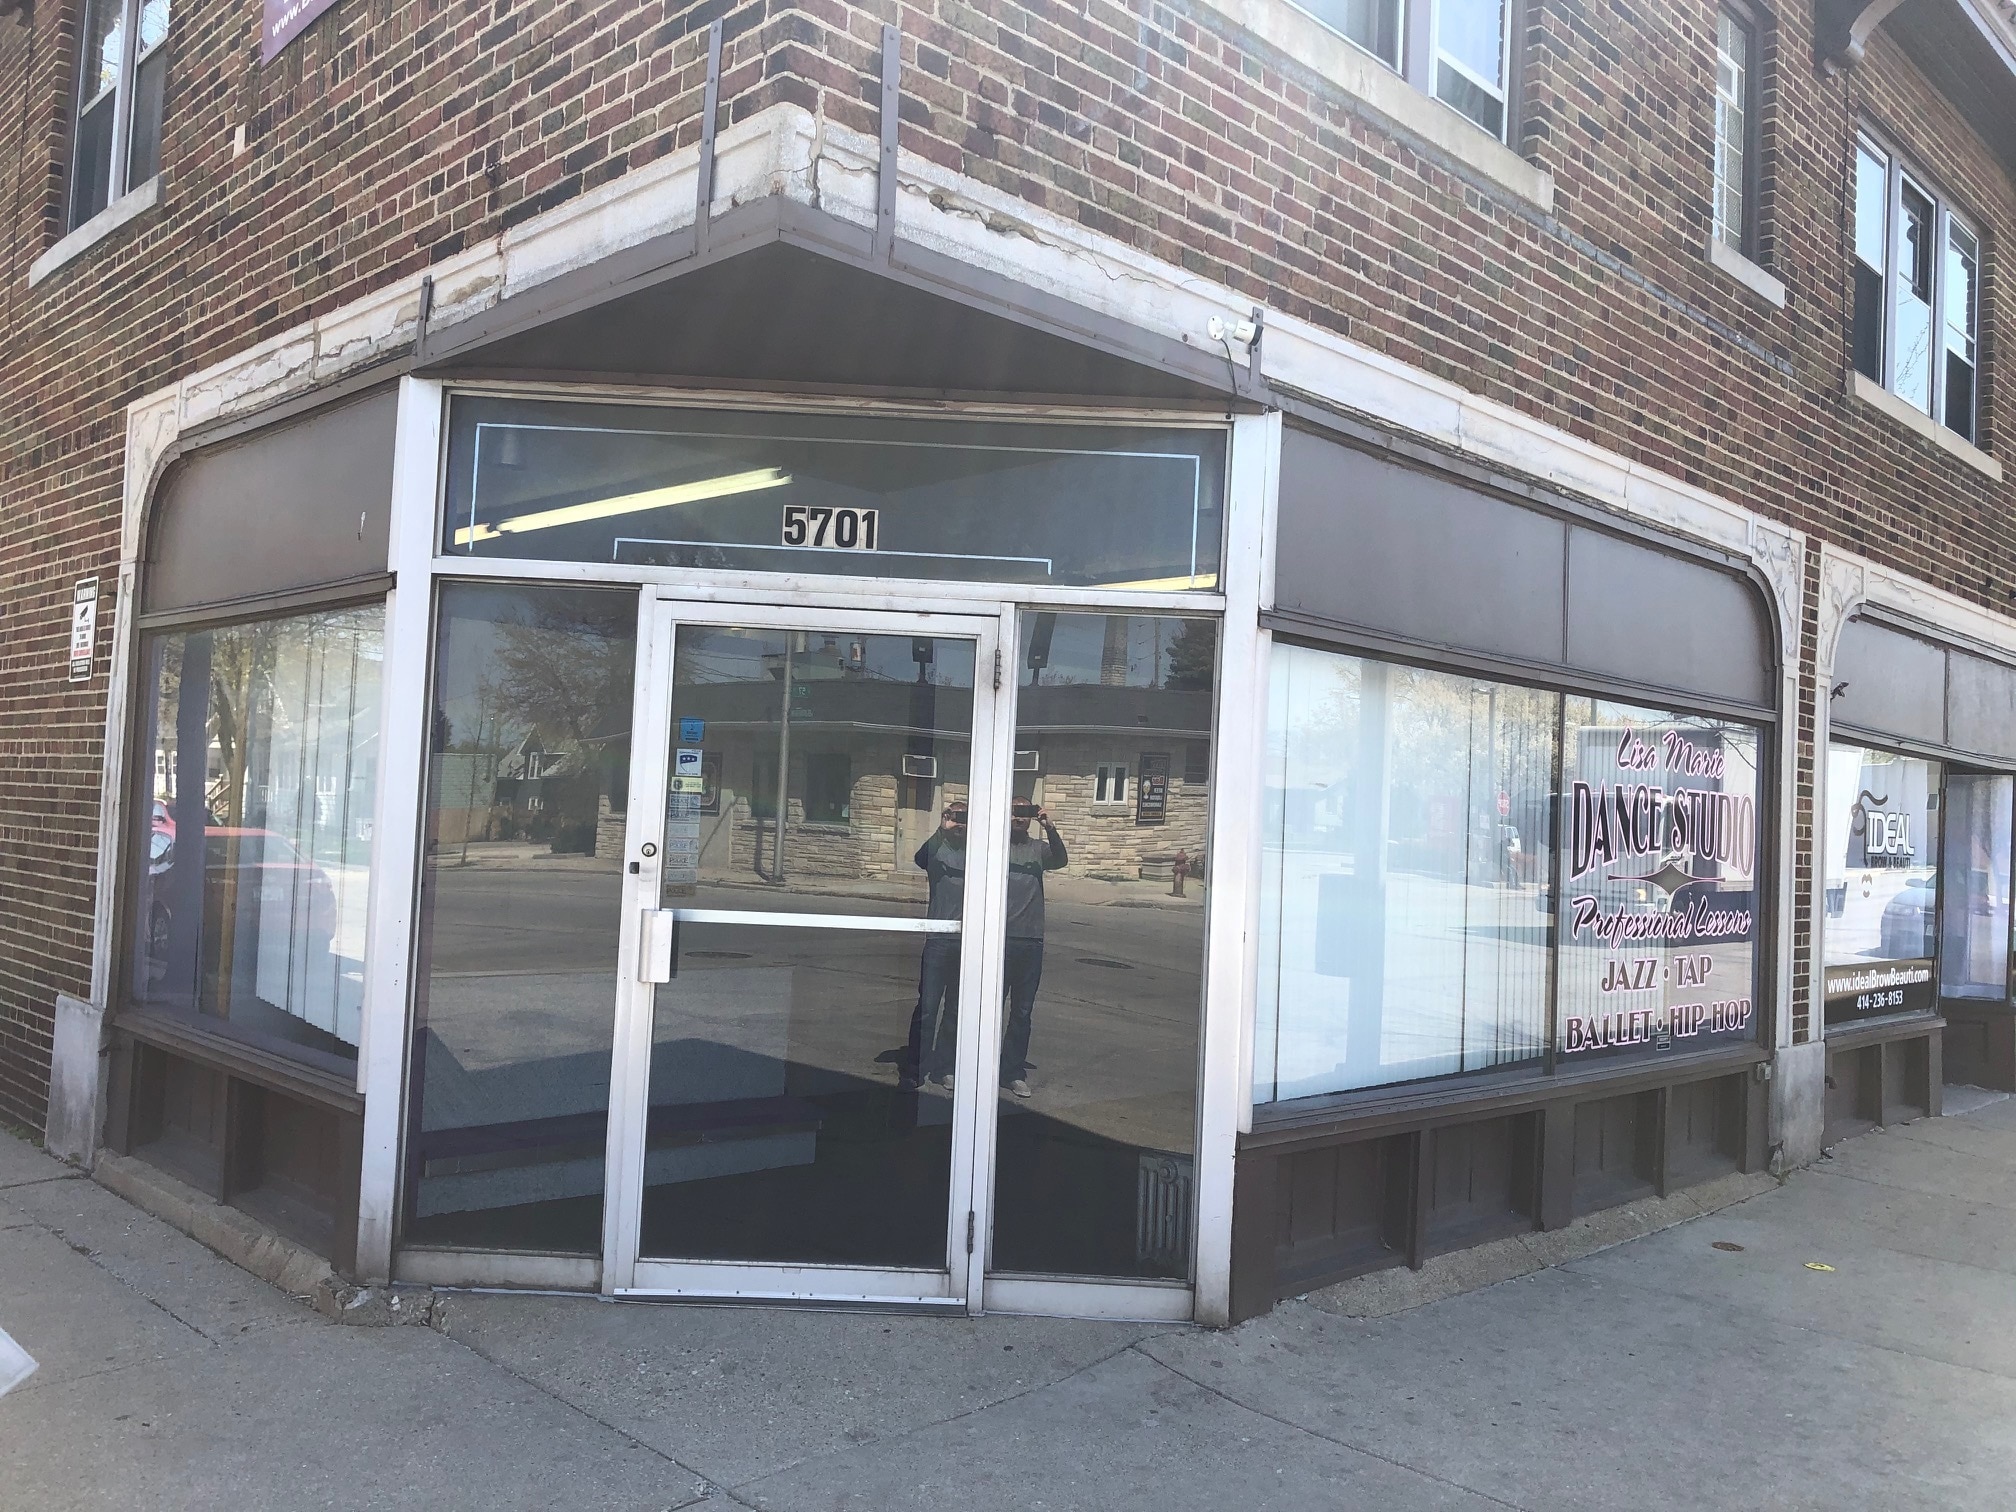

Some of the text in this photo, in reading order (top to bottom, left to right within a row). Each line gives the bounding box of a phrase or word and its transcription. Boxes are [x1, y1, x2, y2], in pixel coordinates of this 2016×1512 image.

[784, 507, 876, 549] 5701
[1617, 727, 1726, 779] Lisa Marie
[1570, 780, 1756, 882] DANCE STUDIO
[1867, 810, 1915, 856] IDEAL
[1571, 895, 1752, 950] Professional Lessons
[1601, 954, 1714, 994] JAZZ TAP
[1827, 966, 1929, 994] www.idealBrowBeauti.com
[1856, 989, 1904, 1010] 414-236-8153
[1564, 999, 1752, 1053] BALLET HIP HOP
